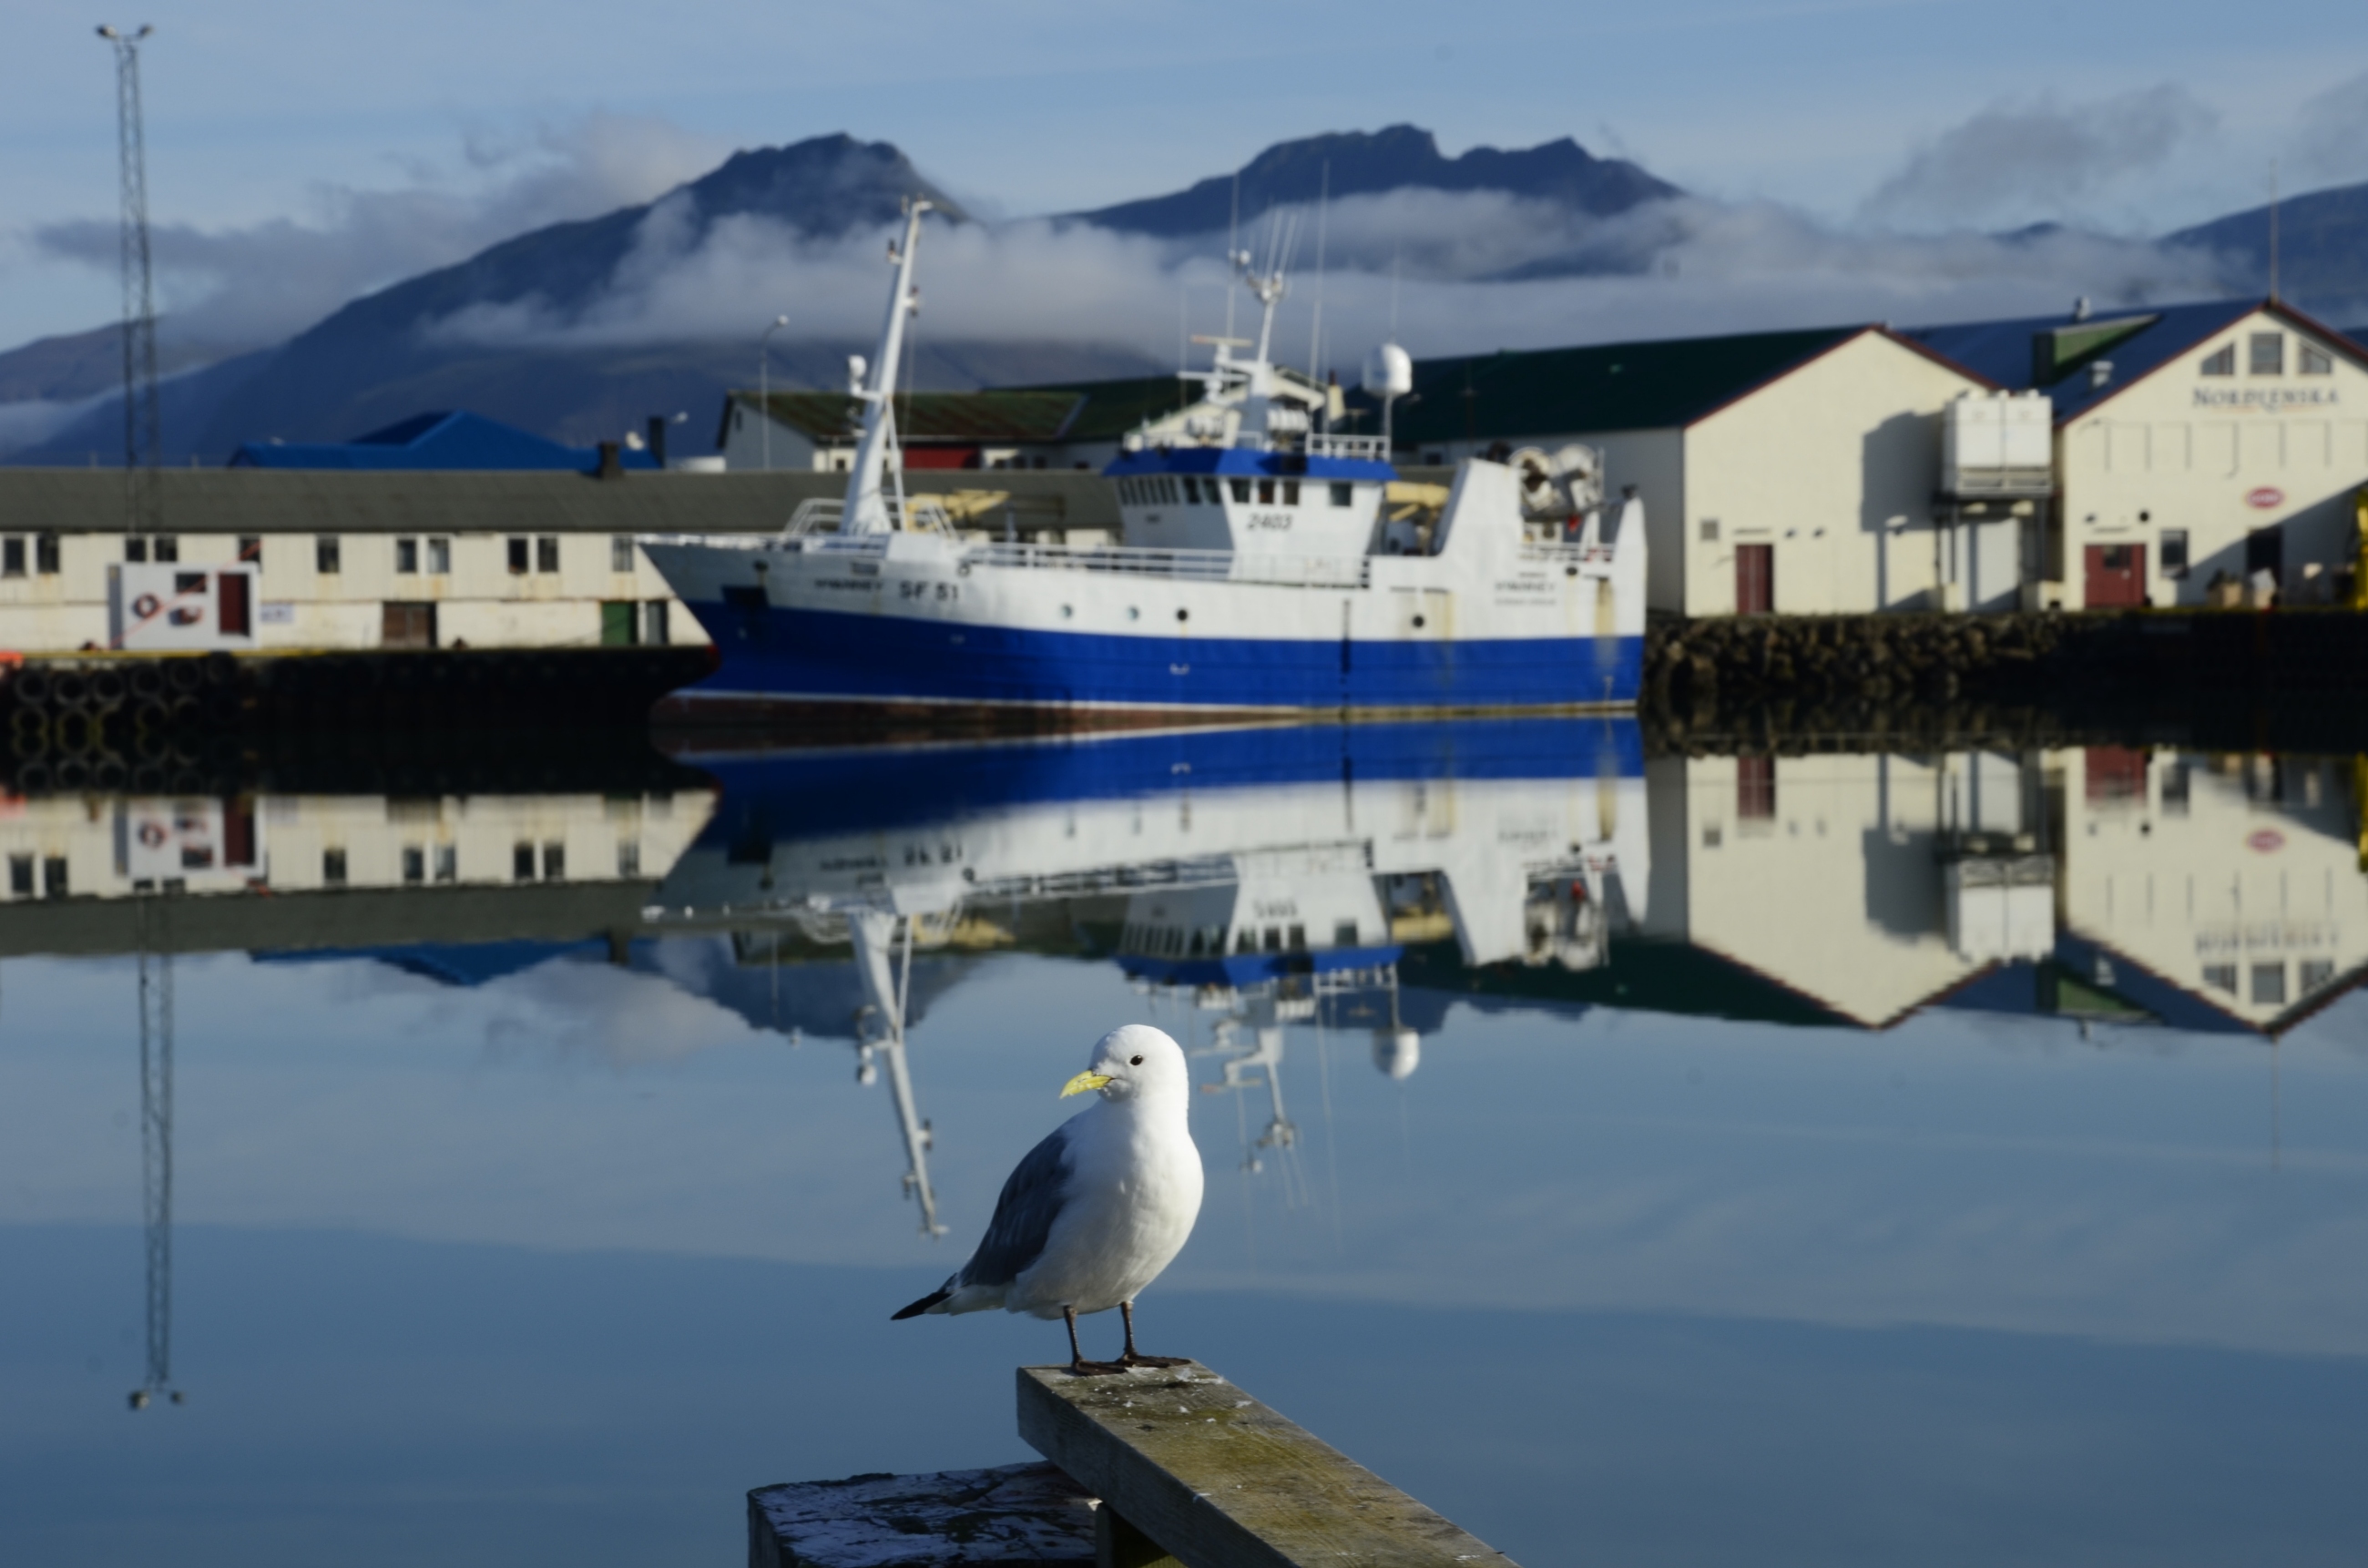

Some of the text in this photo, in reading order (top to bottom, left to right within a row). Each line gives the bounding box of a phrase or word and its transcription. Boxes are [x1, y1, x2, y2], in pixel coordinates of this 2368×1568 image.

[1247, 513, 1292, 530] 2403
[899, 580, 928, 599] SF
[935, 582, 959, 601] 51
